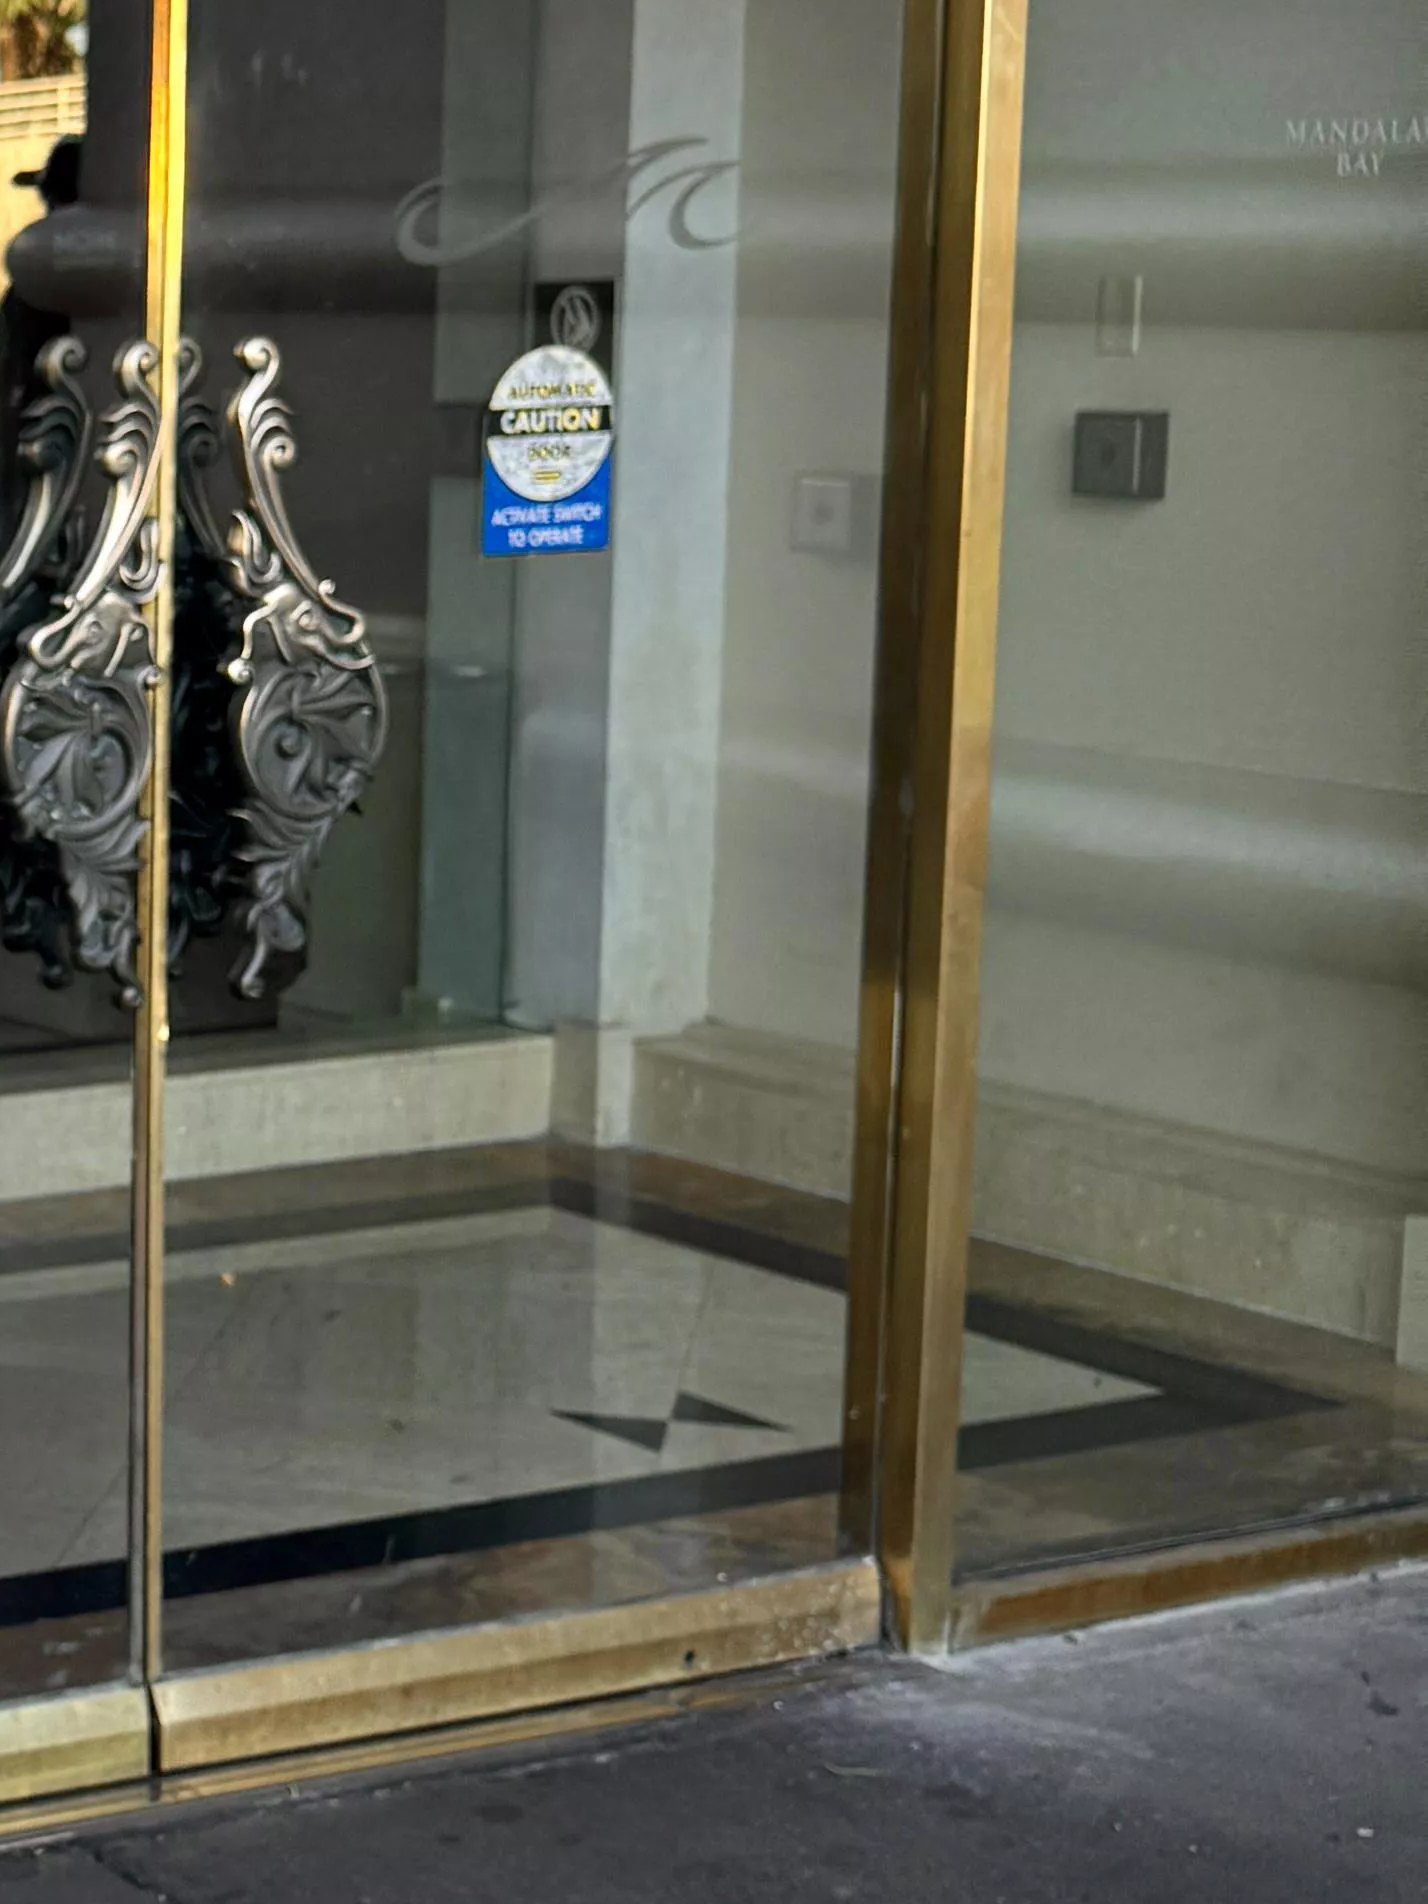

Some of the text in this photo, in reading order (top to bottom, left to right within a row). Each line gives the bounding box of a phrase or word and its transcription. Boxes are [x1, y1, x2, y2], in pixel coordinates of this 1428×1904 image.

[1285, 115, 1428, 147] MANDALA
[1336, 148, 1385, 177] BAY
[500, 408, 601, 434] CAUTION
